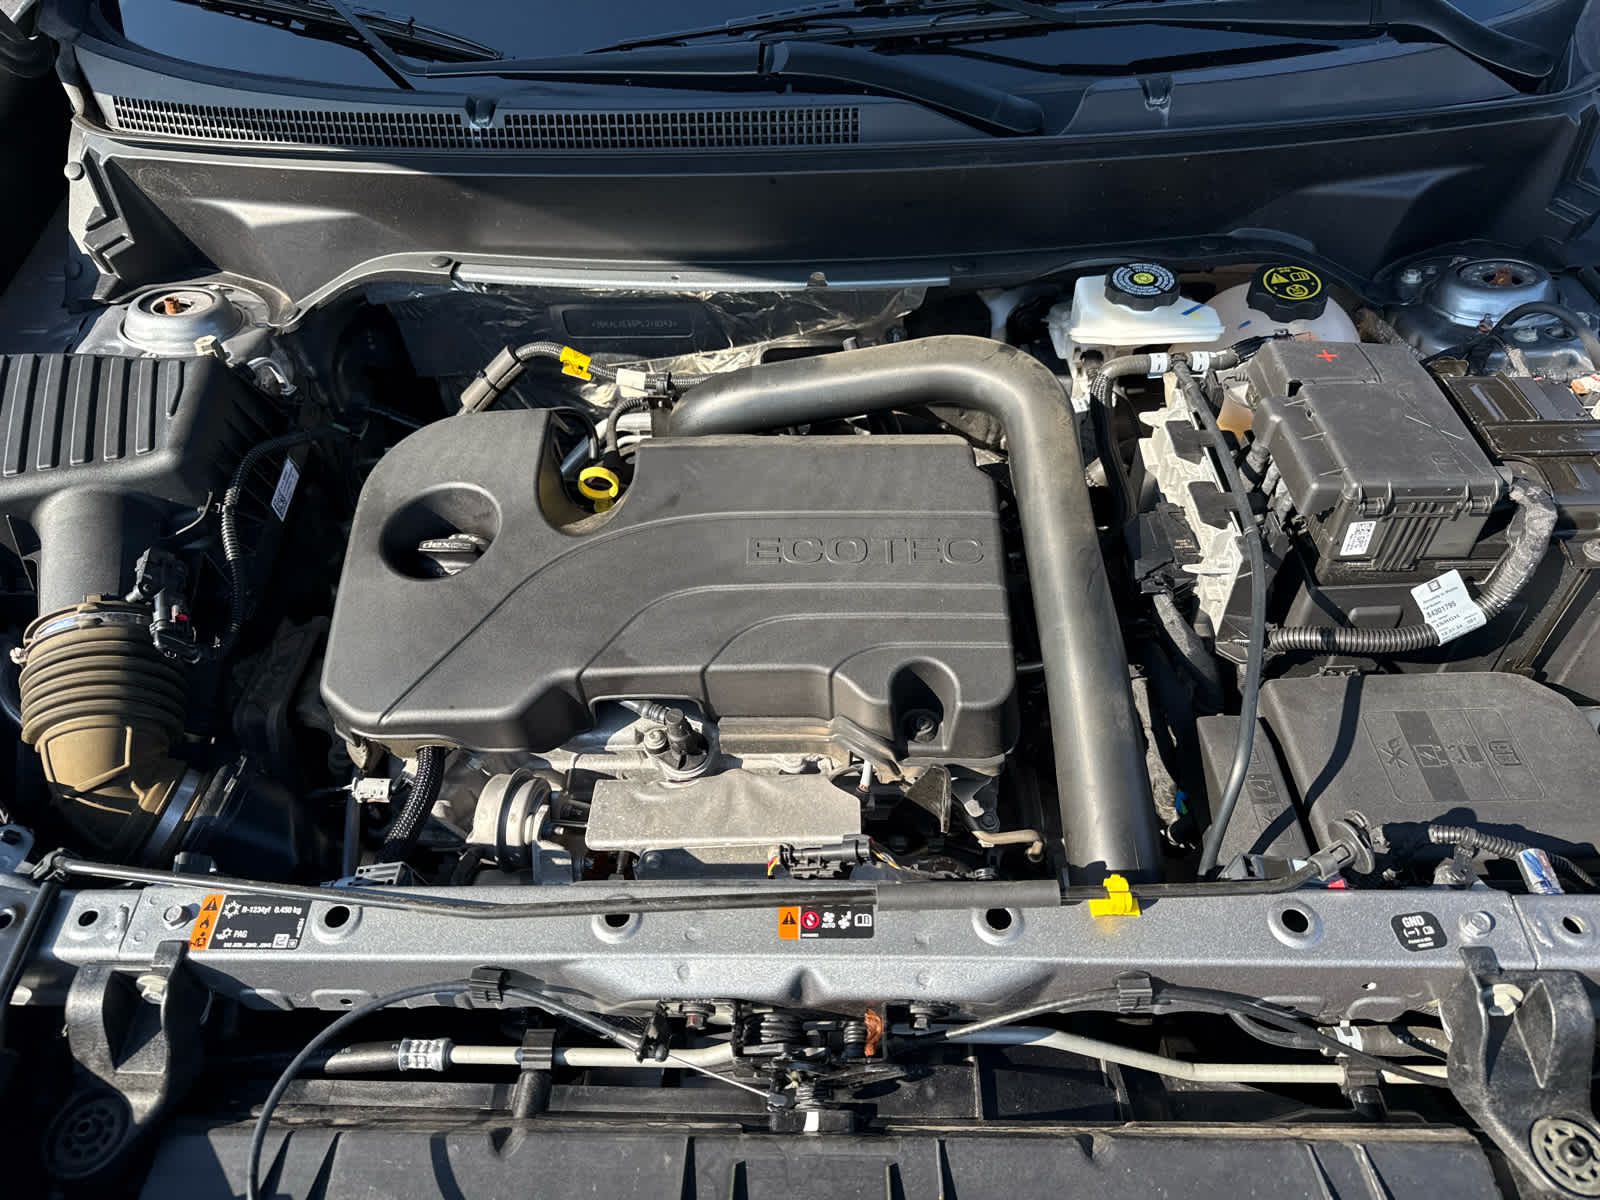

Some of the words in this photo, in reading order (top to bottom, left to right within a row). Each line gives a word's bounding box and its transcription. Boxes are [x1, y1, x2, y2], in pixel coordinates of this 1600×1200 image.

[746, 537, 985, 565] ECOTEC
[1402, 915, 1425, 928] GND
[233, 930, 248, 938] PAG
